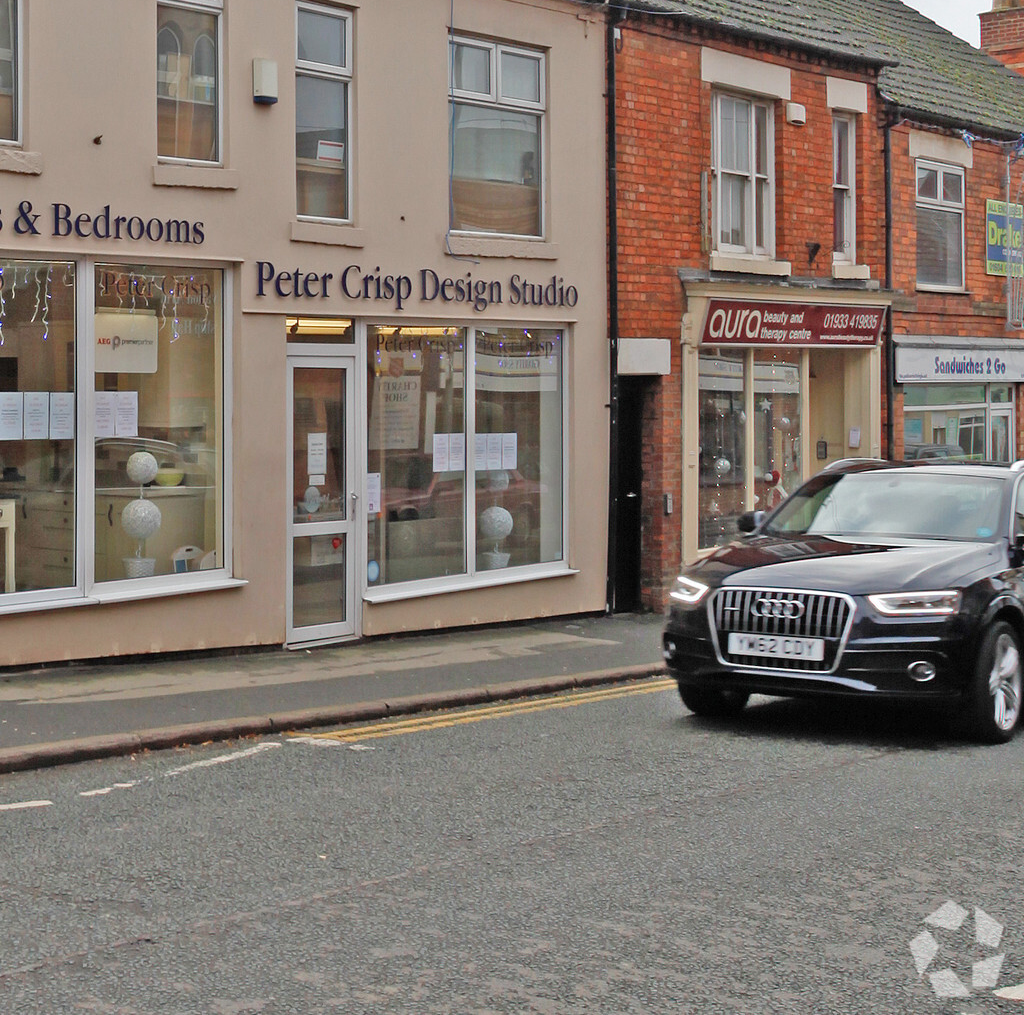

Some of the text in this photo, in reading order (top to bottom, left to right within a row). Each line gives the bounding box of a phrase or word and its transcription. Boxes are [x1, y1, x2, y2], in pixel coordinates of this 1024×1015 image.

[14, 200, 41, 236] &
[52, 203, 205, 245] Bedrooms
[103, 271, 211, 304] Peter Crisp
[256, 261, 578, 312] Peter Crisp Design Studio
[709, 309, 762, 339] aura
[823, 313, 849, 328] 01933
[763, 311, 805, 326] beauty and
[377, 334, 416, 353] Peter
[761, 328, 812, 342] therapy centre
[934, 355, 1006, 374] Sandwiches 2 Go
